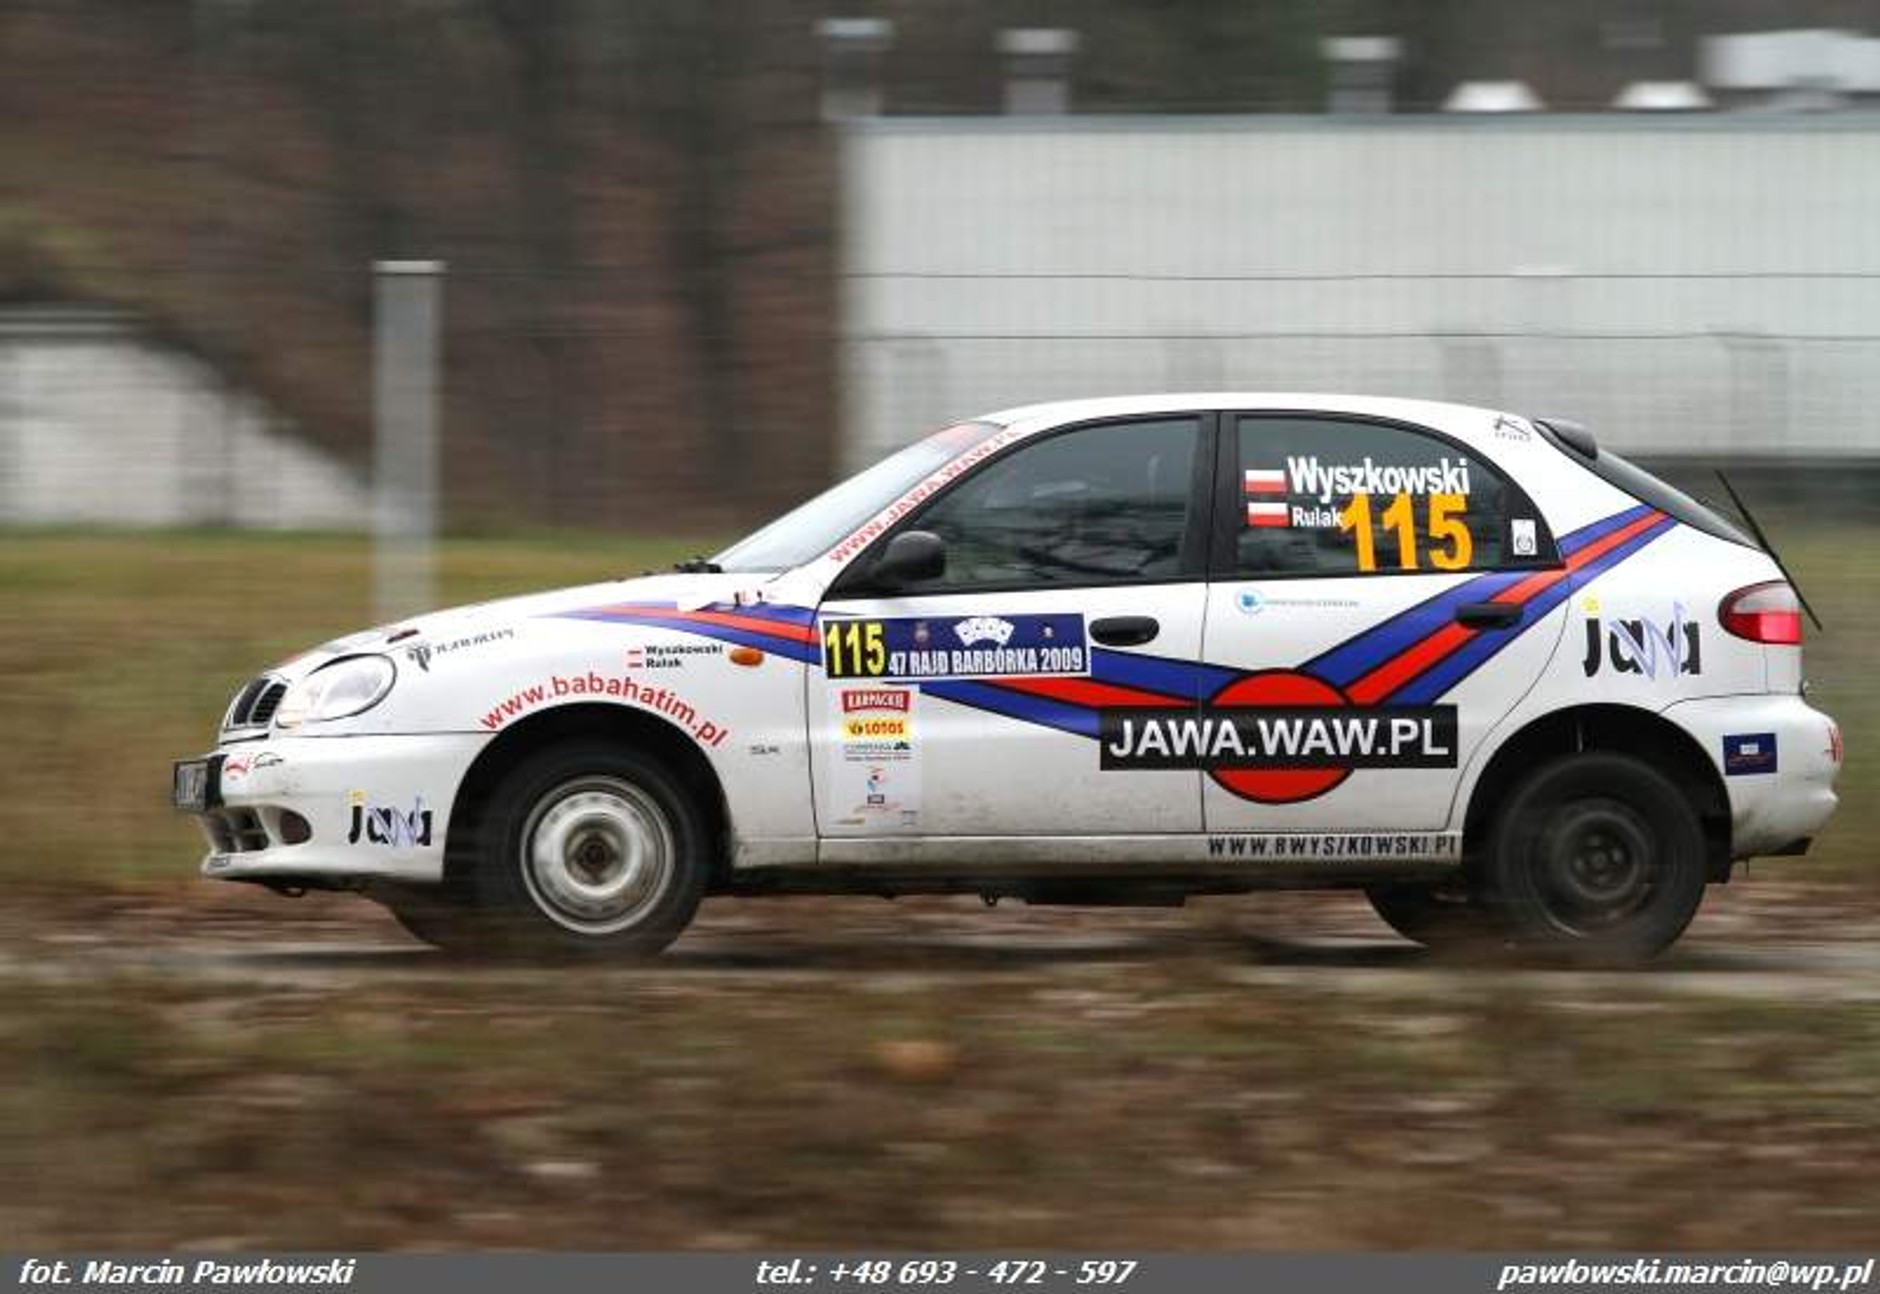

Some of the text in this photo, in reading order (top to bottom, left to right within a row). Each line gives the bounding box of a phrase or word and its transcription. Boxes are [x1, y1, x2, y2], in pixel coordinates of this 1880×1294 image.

[1287, 456, 1470, 503] Wyszkowski
[1292, 506, 1343, 528] Rulak
[1341, 490, 1473, 572] 115
[826, 622, 885, 675] 115
[888, 652, 907, 675] 47
[909, 650, 949, 675] RAJD
[1040, 646, 1083, 671] 2009
[480, 672, 729, 747] www.babahatim.pl
[1109, 717, 1449, 757] JAWA.WAW.PL
